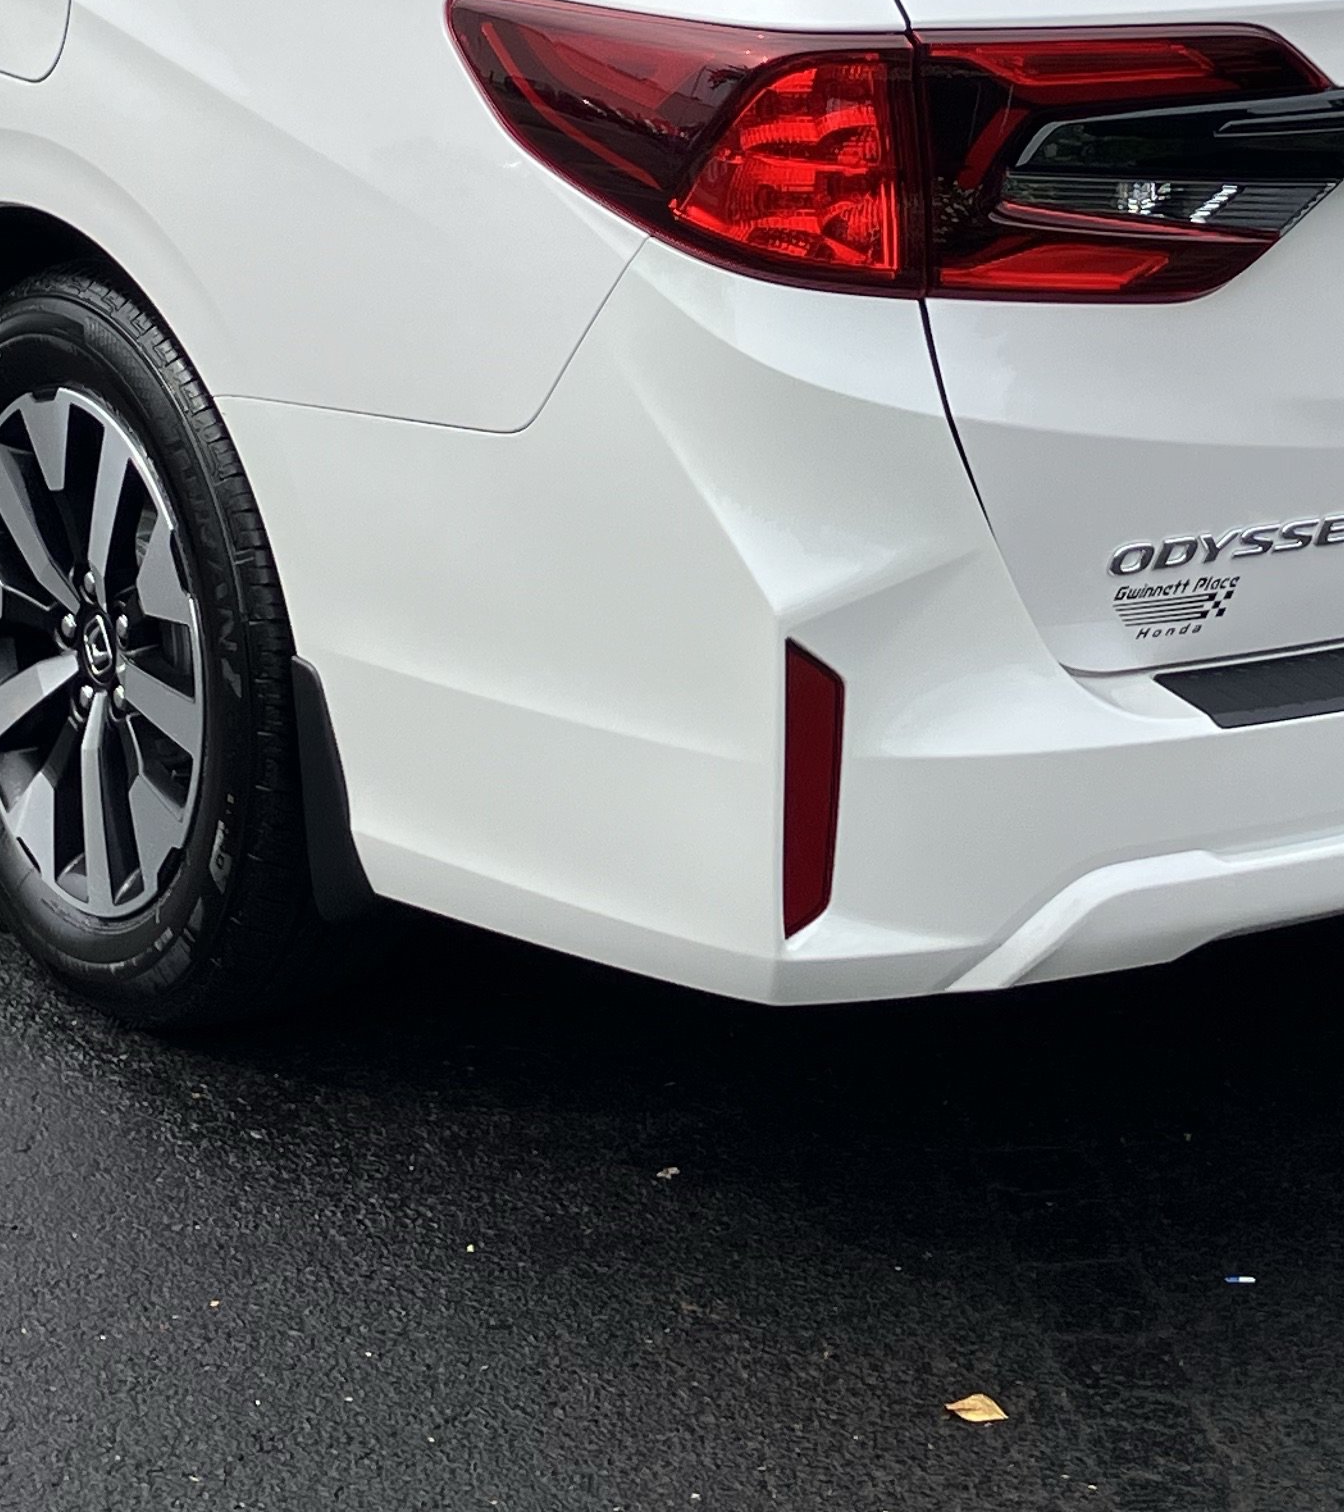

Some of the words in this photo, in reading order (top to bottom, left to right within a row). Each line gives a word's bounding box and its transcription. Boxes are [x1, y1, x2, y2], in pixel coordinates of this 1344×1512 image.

[1113, 579, 1190, 602] Gwinnett
[1192, 575, 1241, 593] Place
[1135, 623, 1202, 640] Honda
